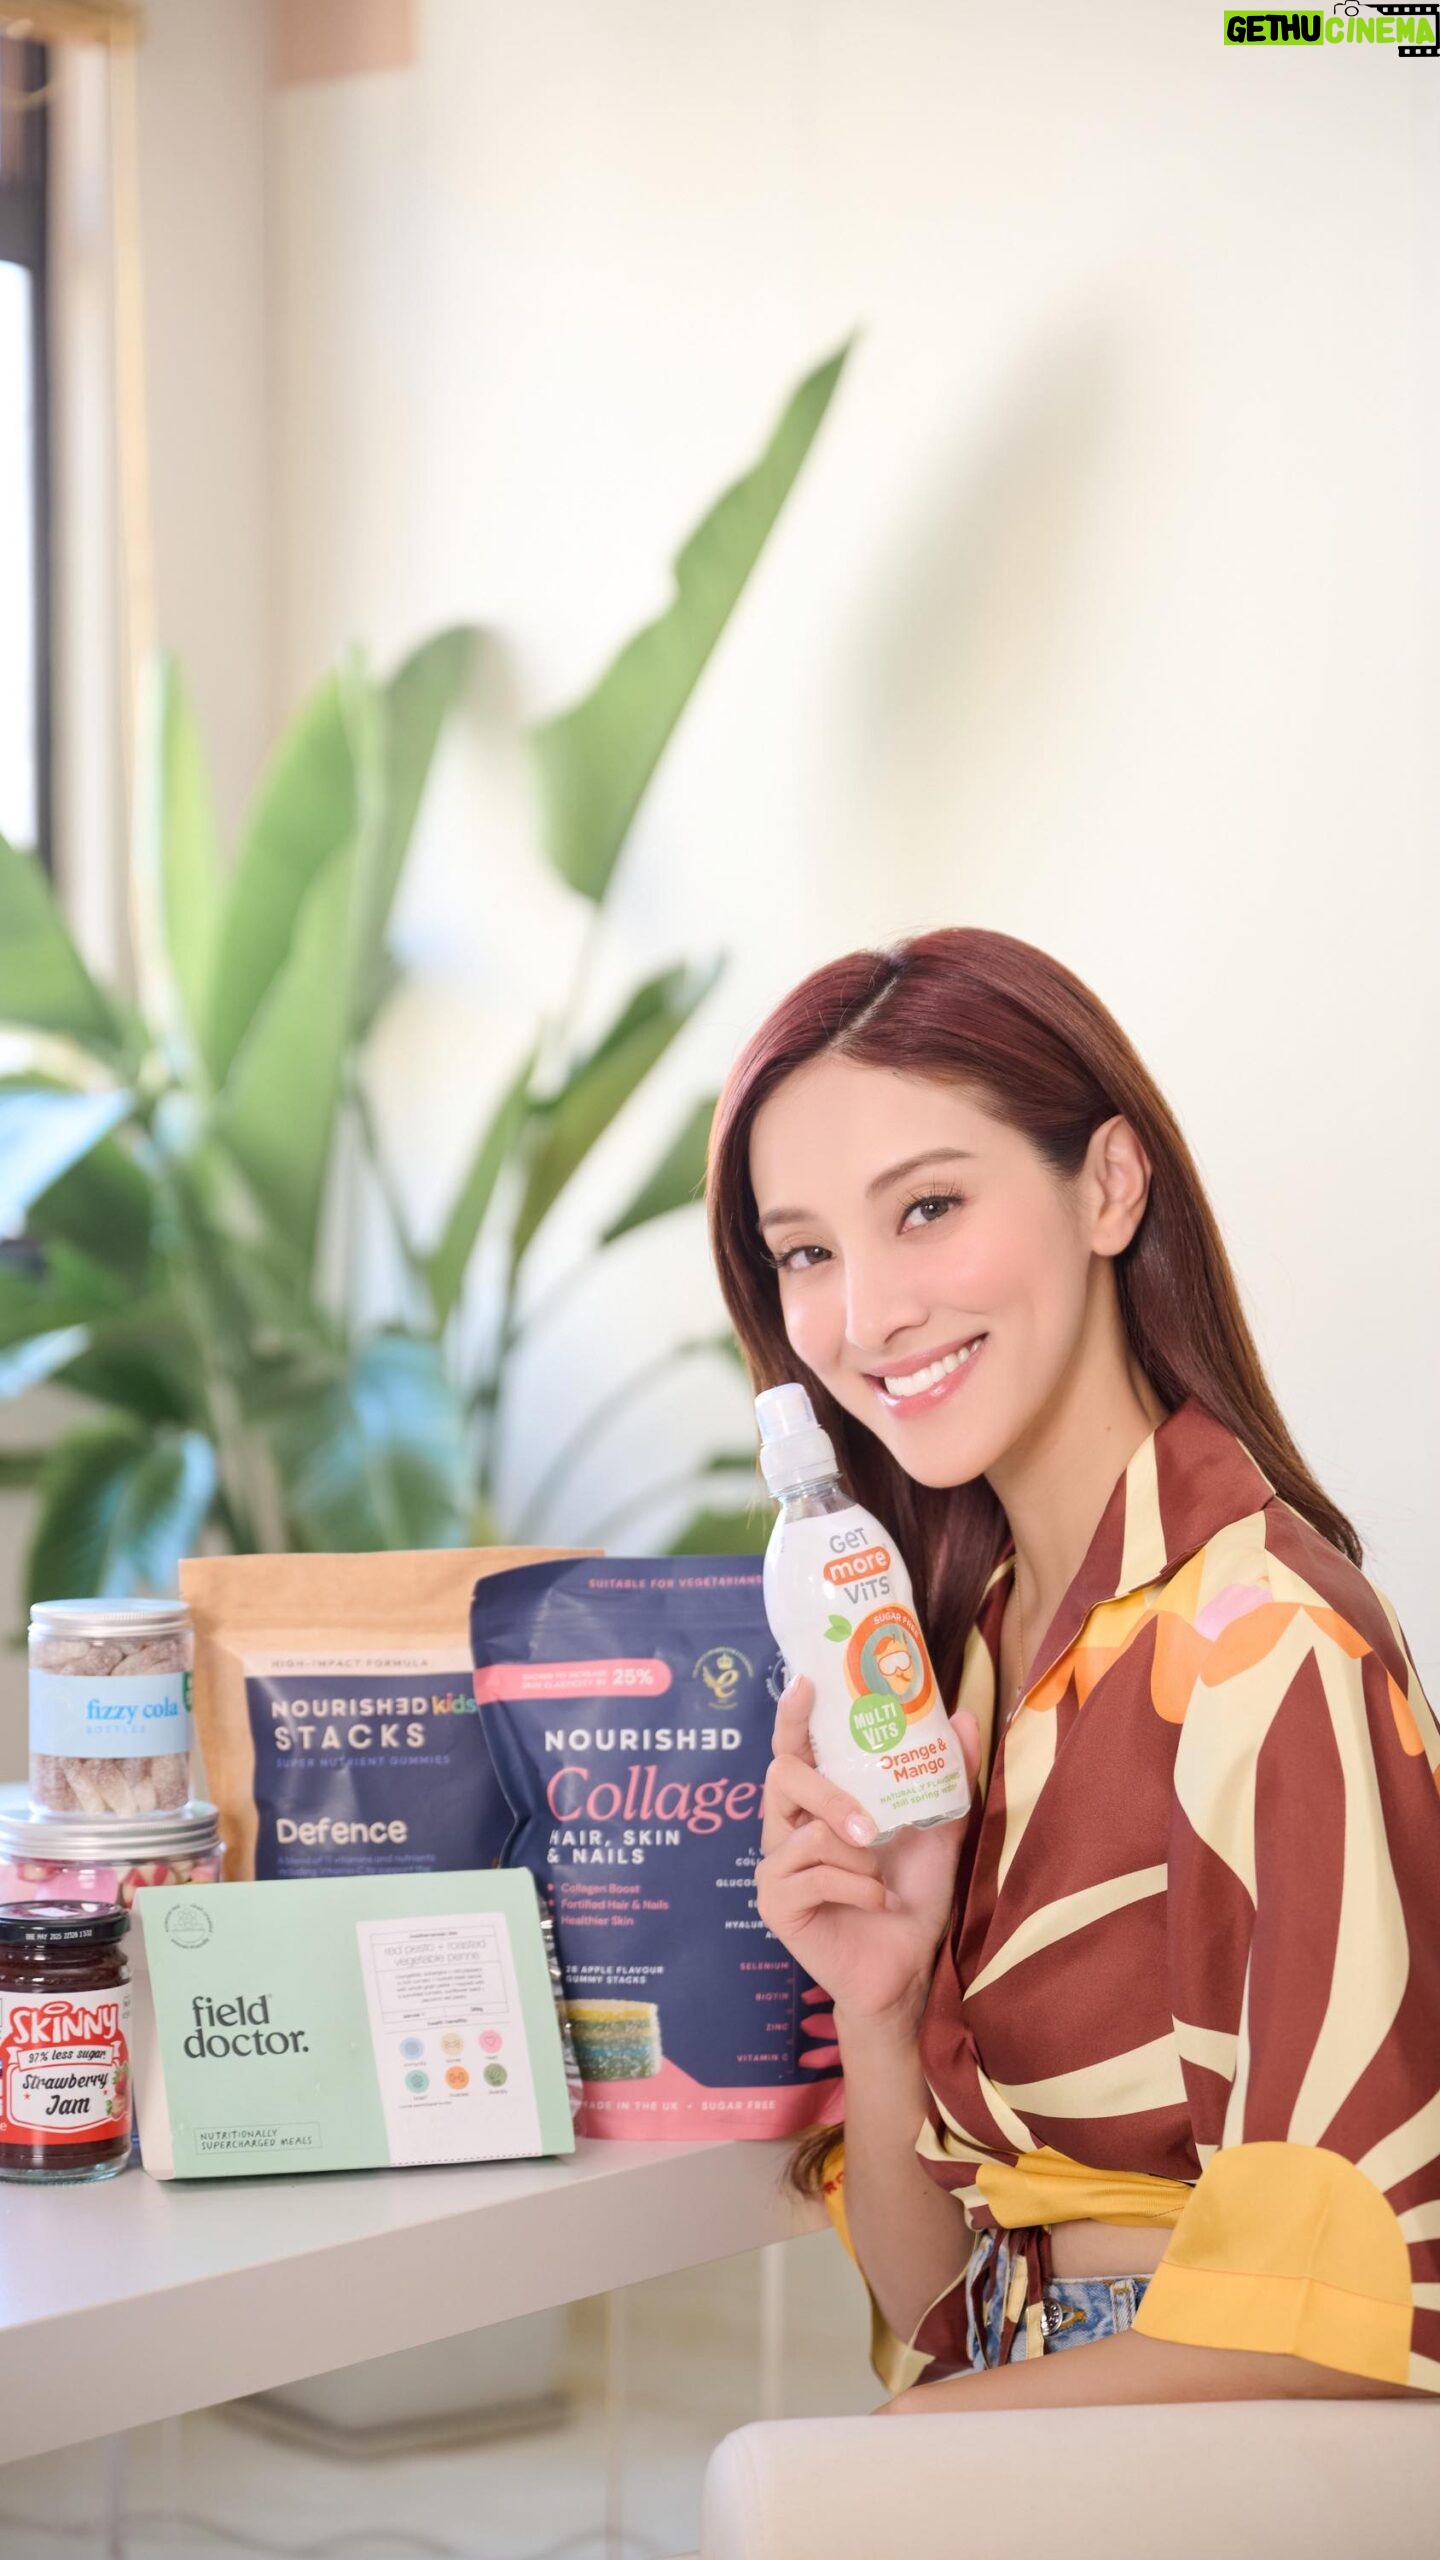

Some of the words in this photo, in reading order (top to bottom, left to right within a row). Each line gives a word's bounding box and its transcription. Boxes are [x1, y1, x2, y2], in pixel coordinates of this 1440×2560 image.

[829, 1550, 888, 1581] more
[588, 1579, 646, 1589] SUITABLE
[651, 1578, 674, 1588] FOR
[873, 1611, 902, 1625] SUGAR
[271, 1658, 361, 1669] HIGH-IMPACT
[366, 1658, 429, 1668] FORMULA
[612, 1667, 654, 1686] 25%
[87, 1698, 138, 1725] fizzy
[142, 1696, 178, 1718] cola
[431, 1693, 479, 1716] kids
[274, 1722, 426, 1751] STACKS
[880, 1743, 937, 1770] Orange
[936, 1737, 947, 1752] &
[893, 1757, 945, 1783] Mango
[880, 1784, 925, 1804] NATURALY
[275, 1817, 408, 1845] Defence
[549, 1830, 612, 1848] HAIR,
[622, 1829, 681, 1846] SKIN
[547, 1850, 559, 1865] &
[572, 1848, 645, 1864] NAILS
[561, 1882, 607, 1895] Collagen
[608, 1883, 640, 1894] Boost
[716, 1878, 757, 1888] GLUCOS
[561, 1899, 606, 1910] Fortified
[607, 1899, 629, 1910] Hair
[631, 1900, 640, 1910] &
[642, 1899, 670, 1910] Nails
[561, 1915, 609, 1926] Healthier
[611, 1915, 635, 1926] Skin
[725, 1920, 764, 1929] HYALUR
[580, 1966, 614, 1974] APPLE
[616, 1966, 664, 1974] FLAVOUR
[566, 1975, 605, 1984] GUMMY
[606, 1975, 647, 1984] STACKS
[191, 1994, 270, 2027] field
[12, 2003, 118, 2045] SKINNY
[765, 2022, 790, 2032] ZINC
[183, 2028, 309, 2059] doctor.
[28, 2051, 48, 2064] 97%
[52, 2049, 74, 2061] less
[736, 2054, 777, 2063] VITAMIN
[782, 2052, 789, 2062] C
[22, 2072, 109, 2089] Strawberry
[45, 2094, 91, 2116] Jam
[616, 2101, 629, 2110] IN
[635, 2101, 656, 2110] THE
[662, 2101, 679, 2110] UK
[701, 2100, 743, 2110] SUGAR
[747, 2099, 776, 2109] FREE
[200, 2129, 278, 2141] NUTRITIONALLY
[201, 2139, 276, 2150] SUPERCHARGED
[280, 2136, 313, 2146] MEALS
